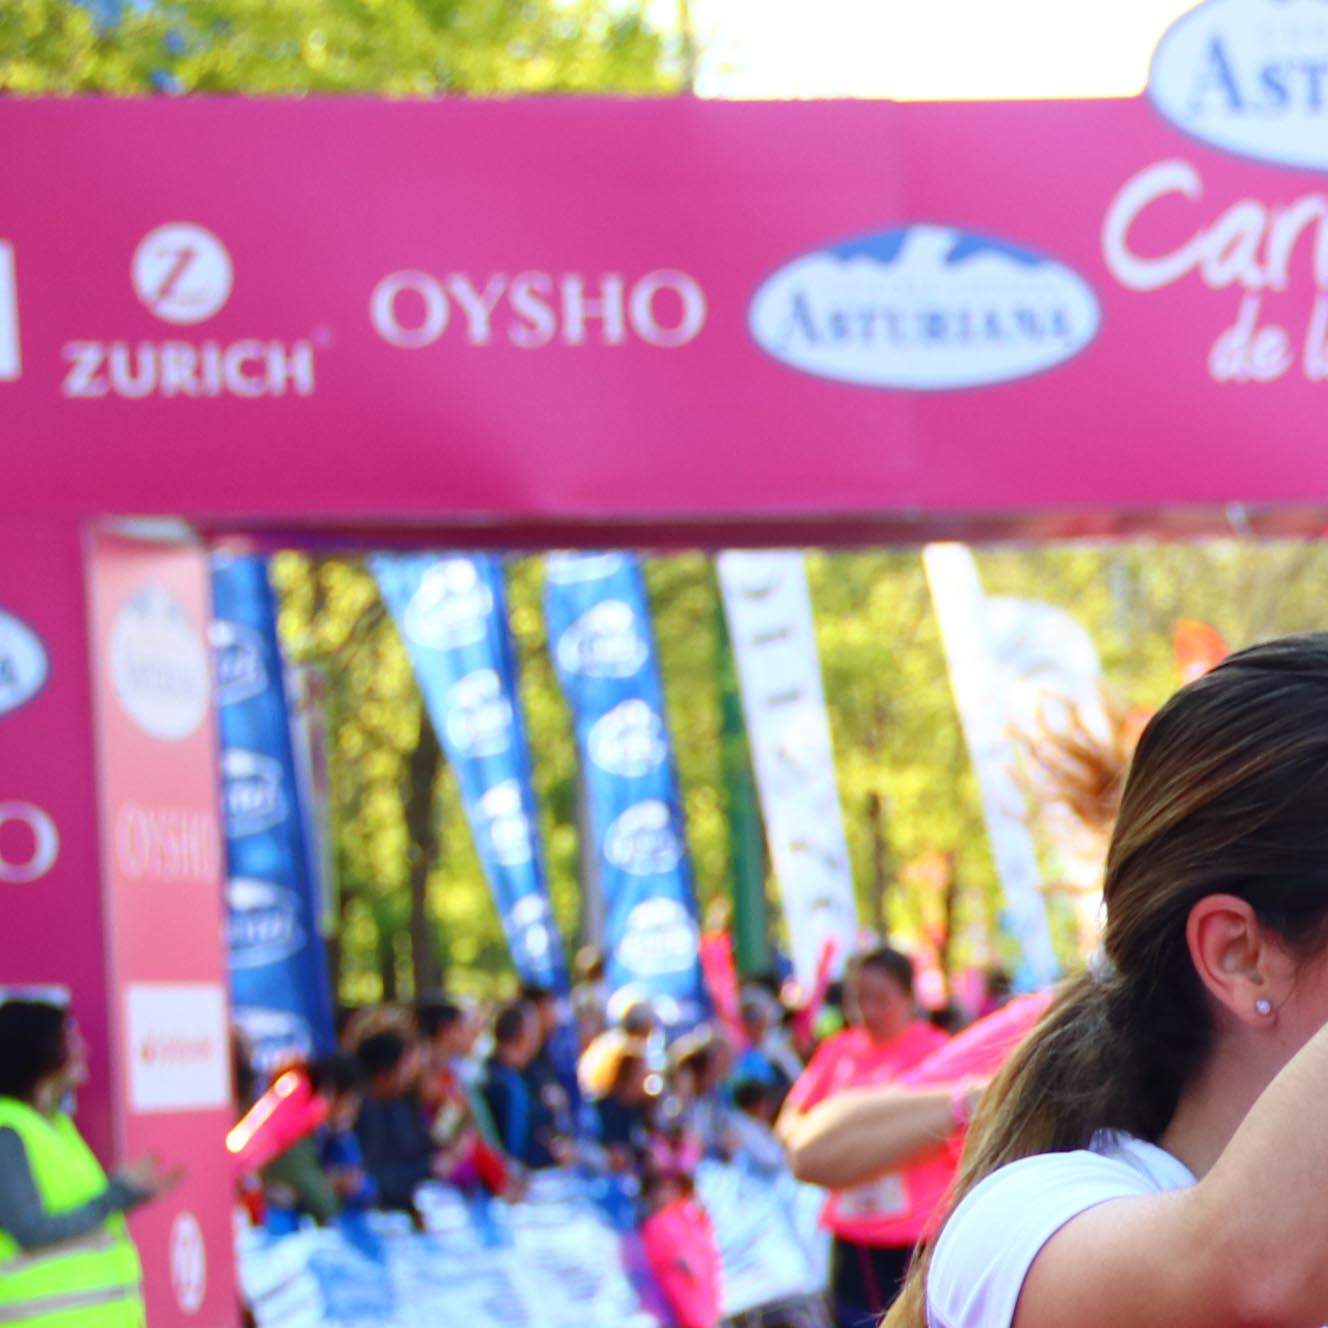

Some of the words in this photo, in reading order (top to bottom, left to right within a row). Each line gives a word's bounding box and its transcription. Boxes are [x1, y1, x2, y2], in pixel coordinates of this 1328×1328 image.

[371, 269, 705, 348] OYSHO
[780, 291, 1075, 347] ASTURIANA
[1210, 292, 1294, 382] de
[62, 338, 316, 398] ZURICH
